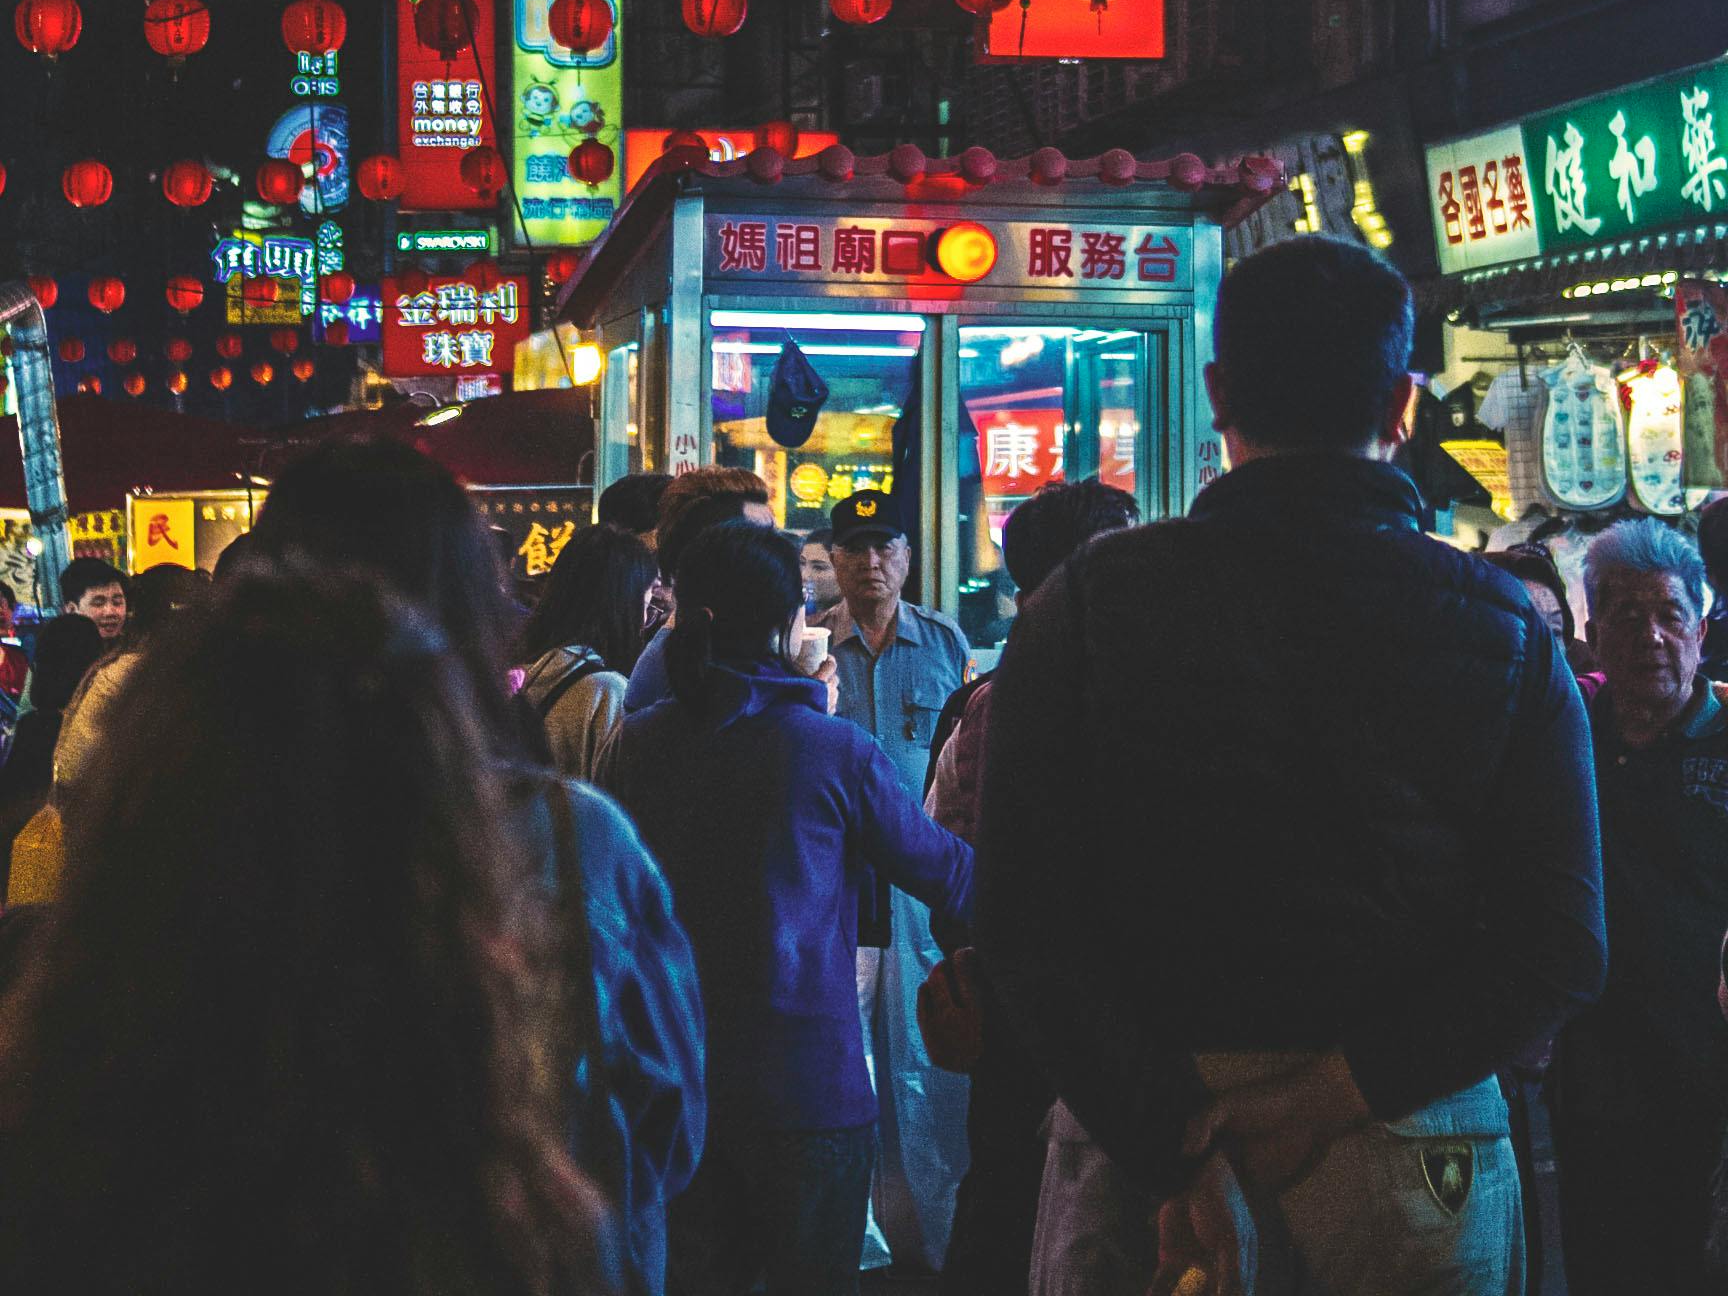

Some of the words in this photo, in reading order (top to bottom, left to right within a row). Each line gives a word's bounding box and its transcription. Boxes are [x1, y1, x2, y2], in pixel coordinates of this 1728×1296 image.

[413, 117, 481, 136] money
[1436, 152, 1532, 245] 各國名藥
[415, 234, 487, 250] SWAROVSKI
[718, 221, 926, 275] 媽祖廟口
[1027, 228, 1181, 282] 服務台
[396, 282, 518, 326] 金瑞利
[422, 330, 495, 368] 珠寶
[147, 513, 179, 550] 民
